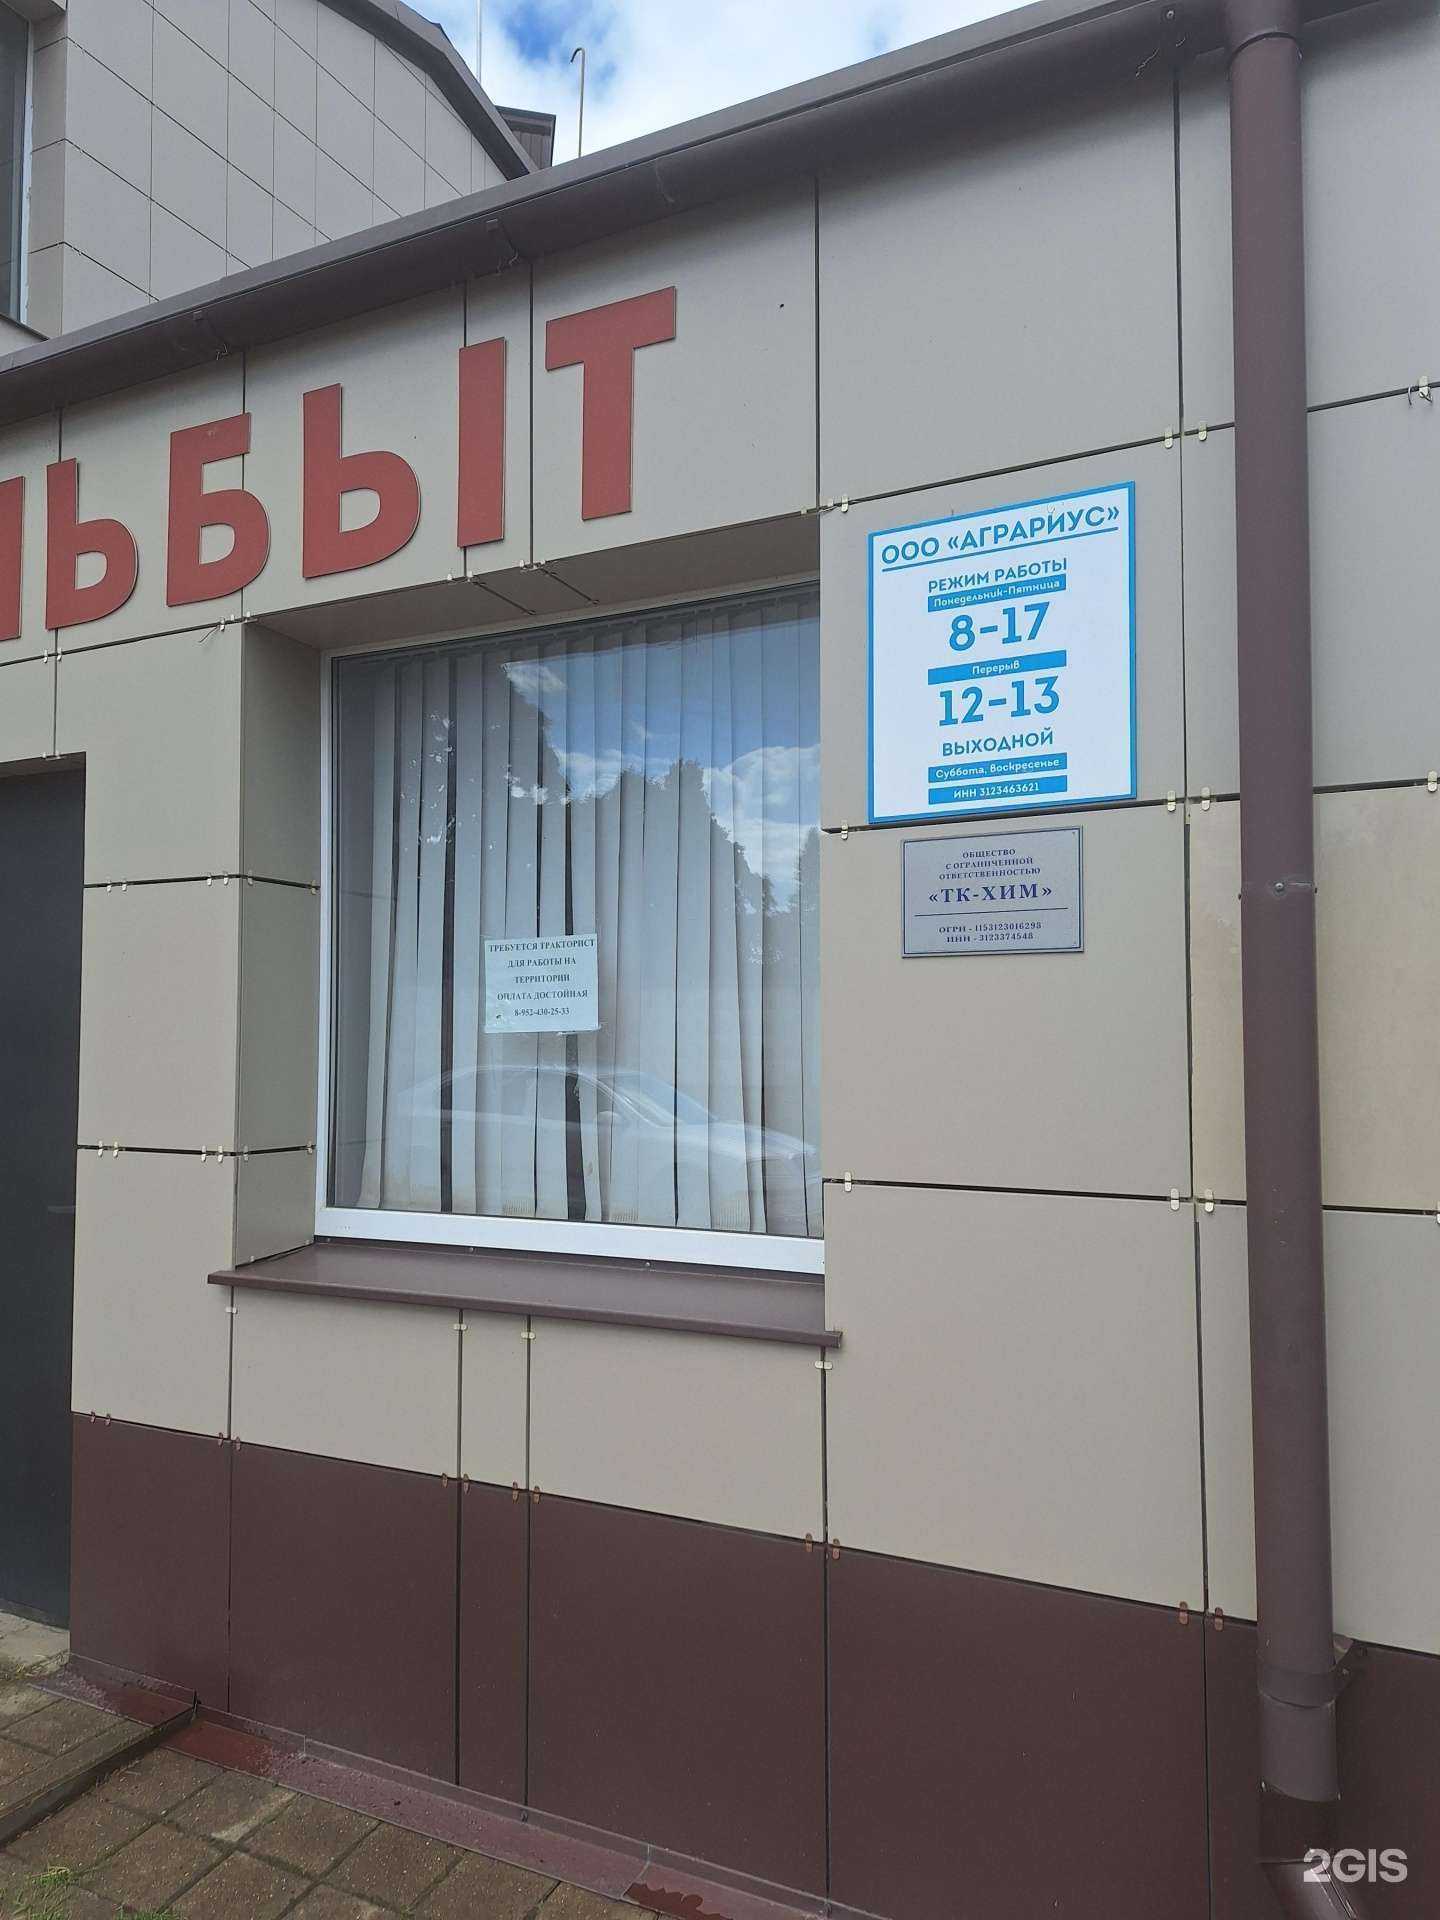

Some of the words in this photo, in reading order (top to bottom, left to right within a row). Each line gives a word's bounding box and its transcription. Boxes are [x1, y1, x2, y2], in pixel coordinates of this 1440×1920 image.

[881, 537, 940, 564] ООО
[948, 505, 1120, 552] «АГРАРИУС»
[928, 571, 990, 594] РЕЖИМ
[994, 557, 1067, 582] РАБОТЫ
[933, 580, 1061, 607] Понедельник-Пятница
[949, 601, 1050, 651] 8-17
[972, 660, 1020, 676] Перерыв
[939, 675, 1060, 726] 12-13
[942, 727, 1053, 757] ВЫХОДНОЙ
[935, 767, 988, 780] Суббота,
[953, 788, 977, 799] ИНН
[979, 782, 1040, 797] 3123463621
[962, 848, 1016, 859] ОБЩЕСТВО
[953, 856, 1034, 870] ОГРАНИЧЕННОЙ
[939, 867, 1041, 881] ОТВЕТСТВЕННОСТЬЮ
[929, 883, 1052, 903] «ТК-ХИМ»
[938, 925, 967, 934] ОГРН
[488, 942, 538, 953] ТРЕБУЕТСЯ
[540, 939, 594, 951] ТРАКТОРИСТ
[946, 935, 971, 943] ИНН
[507, 958, 525, 969] ДЛЯ
[527, 957, 563, 967] РАБОТЫ
[564, 956, 577, 965] НА
[514, 973, 570, 984] ТЕРРИТОРИИ
[497, 991, 532, 1002] ОПЛАТА
[534, 988, 588, 1001] ДОСТОЙНАЯ
